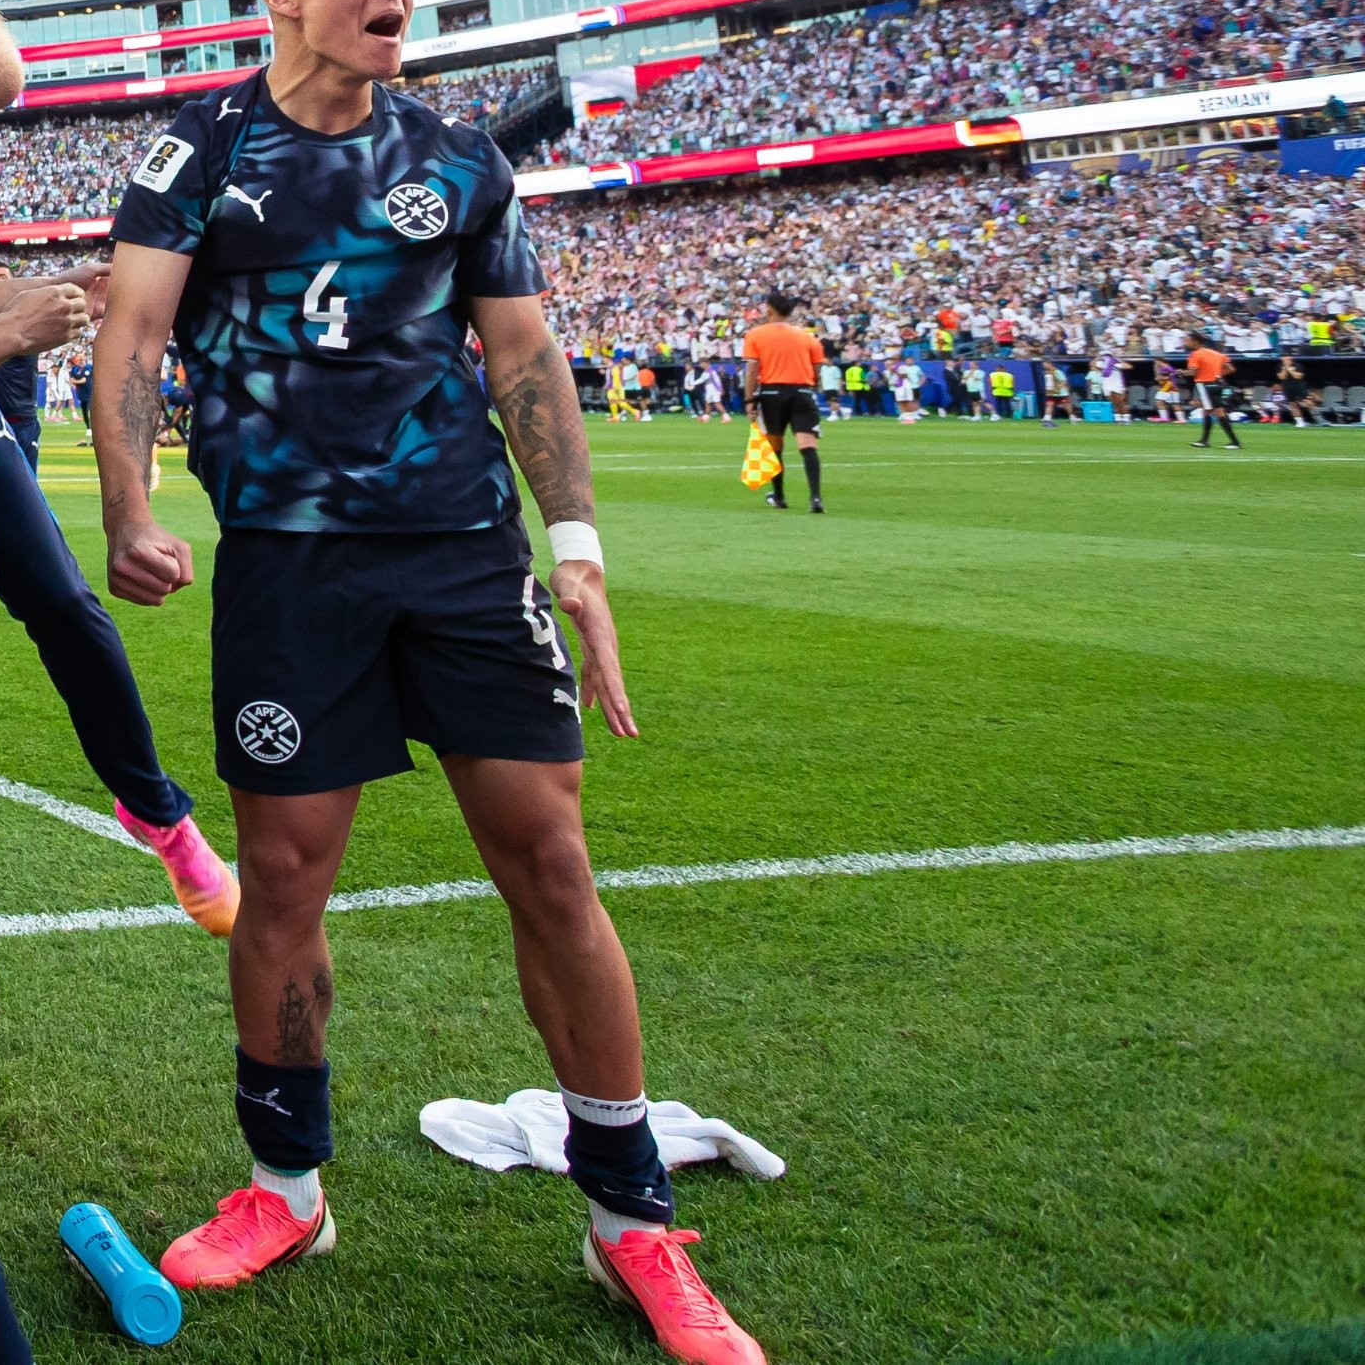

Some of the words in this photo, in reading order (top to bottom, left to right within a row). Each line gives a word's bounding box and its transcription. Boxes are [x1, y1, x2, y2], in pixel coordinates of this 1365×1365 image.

[1199, 91, 1270, 112] GERMANY
[405, 187, 426, 199] APF
[302, 260, 349, 350] 4
[521, 573, 567, 671] 4
[255, 706, 276, 717] APF
